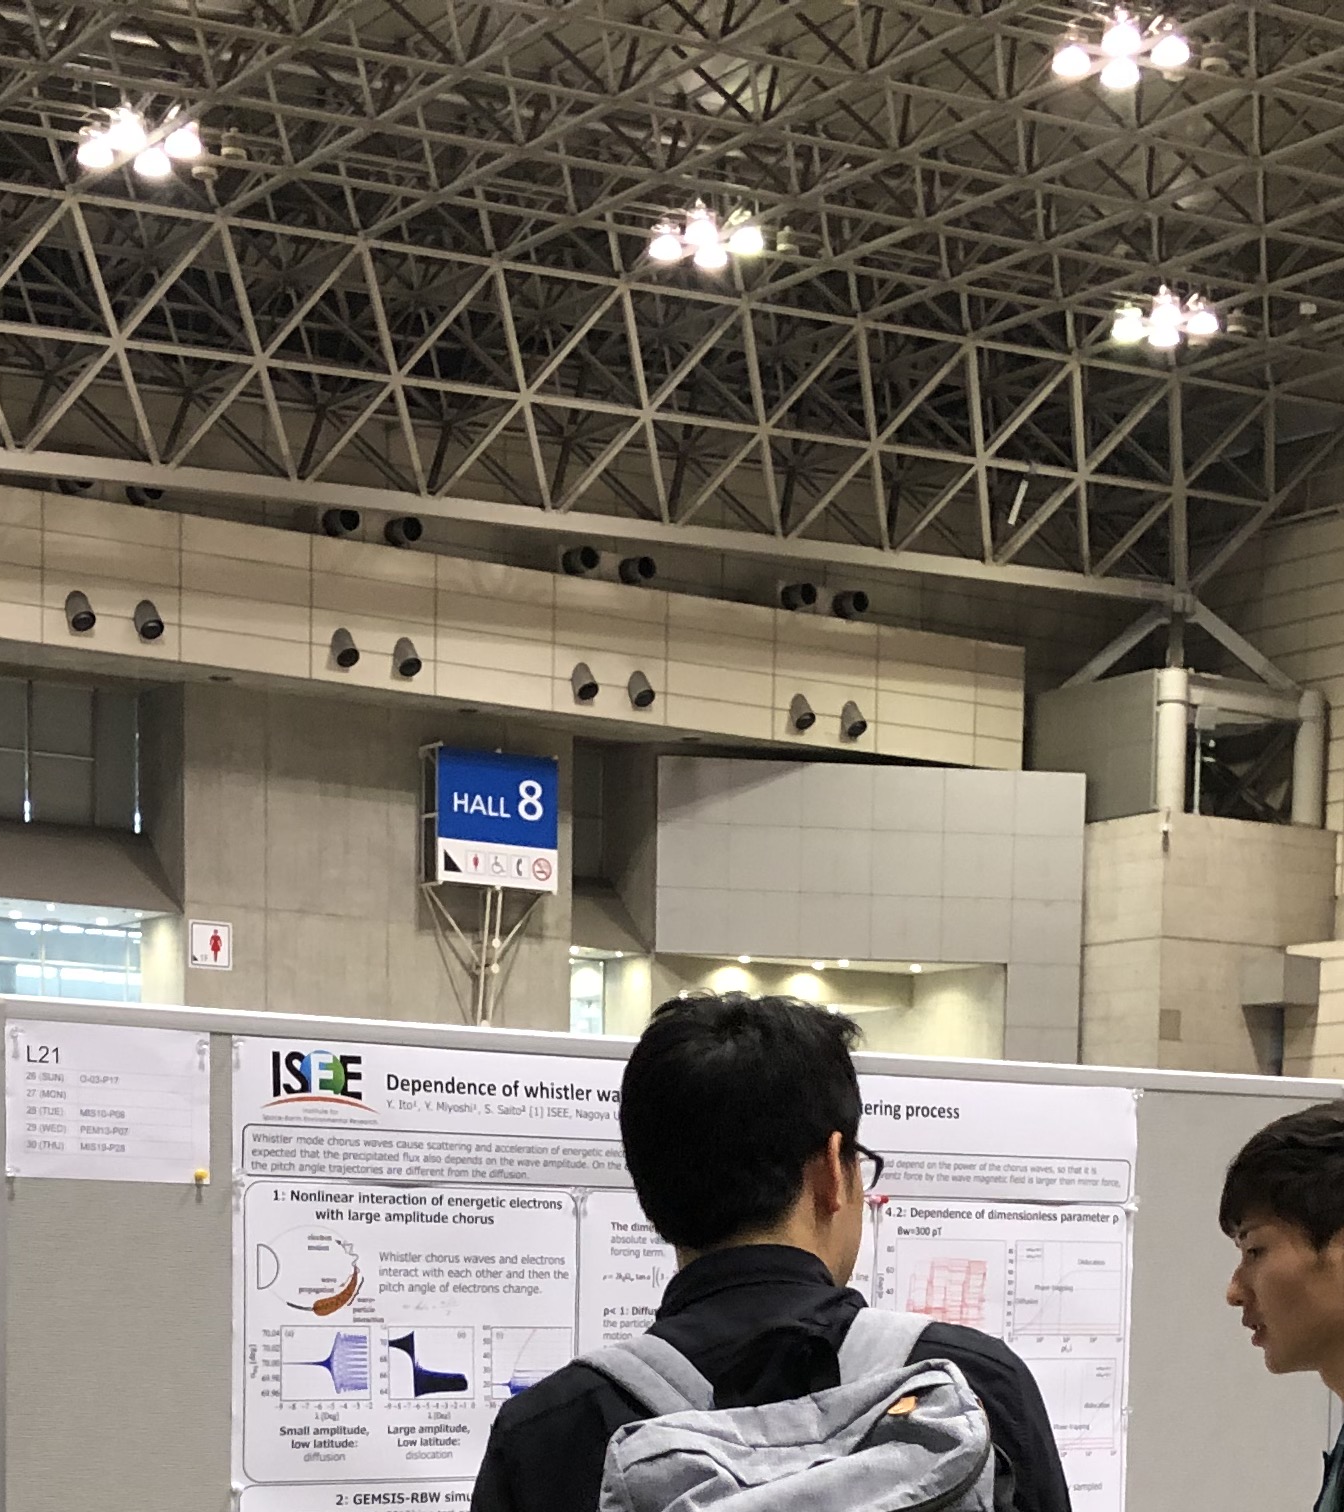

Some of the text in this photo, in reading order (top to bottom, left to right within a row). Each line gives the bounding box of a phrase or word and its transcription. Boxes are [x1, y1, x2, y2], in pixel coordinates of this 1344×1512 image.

[453, 780, 543, 821] HALL 8
[26, 1045, 60, 1063] L21
[272, 1050, 362, 1100] ISEE
[26, 1089, 36, 1098] 27
[386, 1074, 622, 1103] Dependence of whistler wa
[39, 1106, 64, 1116] (TUE)
[576, 1111, 610, 1121] Nagoya
[906, 1103, 959, 1120] process
[252, 1133, 602, 1157] Whistler mode chorus waves cause scattering and acceleration of energetic
[252, 1149, 296, 1159] expected
[300, 1149, 320, 1159] that
[323, 1150, 339, 1159] the
[343, 1151, 399, 1161] precipitated
[403, 1152, 420, 1162] flux
[422, 1153, 442, 1163] also
[445, 1154, 482, 1166] depends
[485, 1157, 496, 1165] on
[500, 1157, 514, 1166] the
[592, 1161, 604, 1169] On
[608, 1161, 621, 1170] the
[251, 1161, 486, 1178] the pitch angle trajectories are different from the
[273, 1190, 562, 1210] 1: Nonlinear interaction of energetic electrons
[316, 1209, 494, 1224] with large amplitude chorus
[910, 1208, 972, 1220] Dependence
[975, 1208, 984, 1218] of
[988, 1208, 1057, 1221] dimensionless
[1060, 1213, 1110, 1224] parameter
[611, 1222, 628, 1231] The
[379, 1251, 421, 1263] Whistler
[425, 1253, 460, 1263] chorus
[499, 1255, 517, 1265] and
[521, 1255, 565, 1265] electrons
[379, 1267, 569, 1280] interact with each other and then the
[379, 1282, 542, 1296] pitch angle of electrons change.
[280, 1425, 369, 1437] Small amplitude,
[388, 1424, 470, 1435] Large amplitude,
[291, 1440, 310, 1449] low
[398, 1439, 417, 1447] Low
[304, 1452, 345, 1462] diffusion
[406, 1450, 453, 1460] dislocation
[336, 1495, 349, 1505] 2:
[353, 1492, 441, 1505] GEMSIS-RBW
